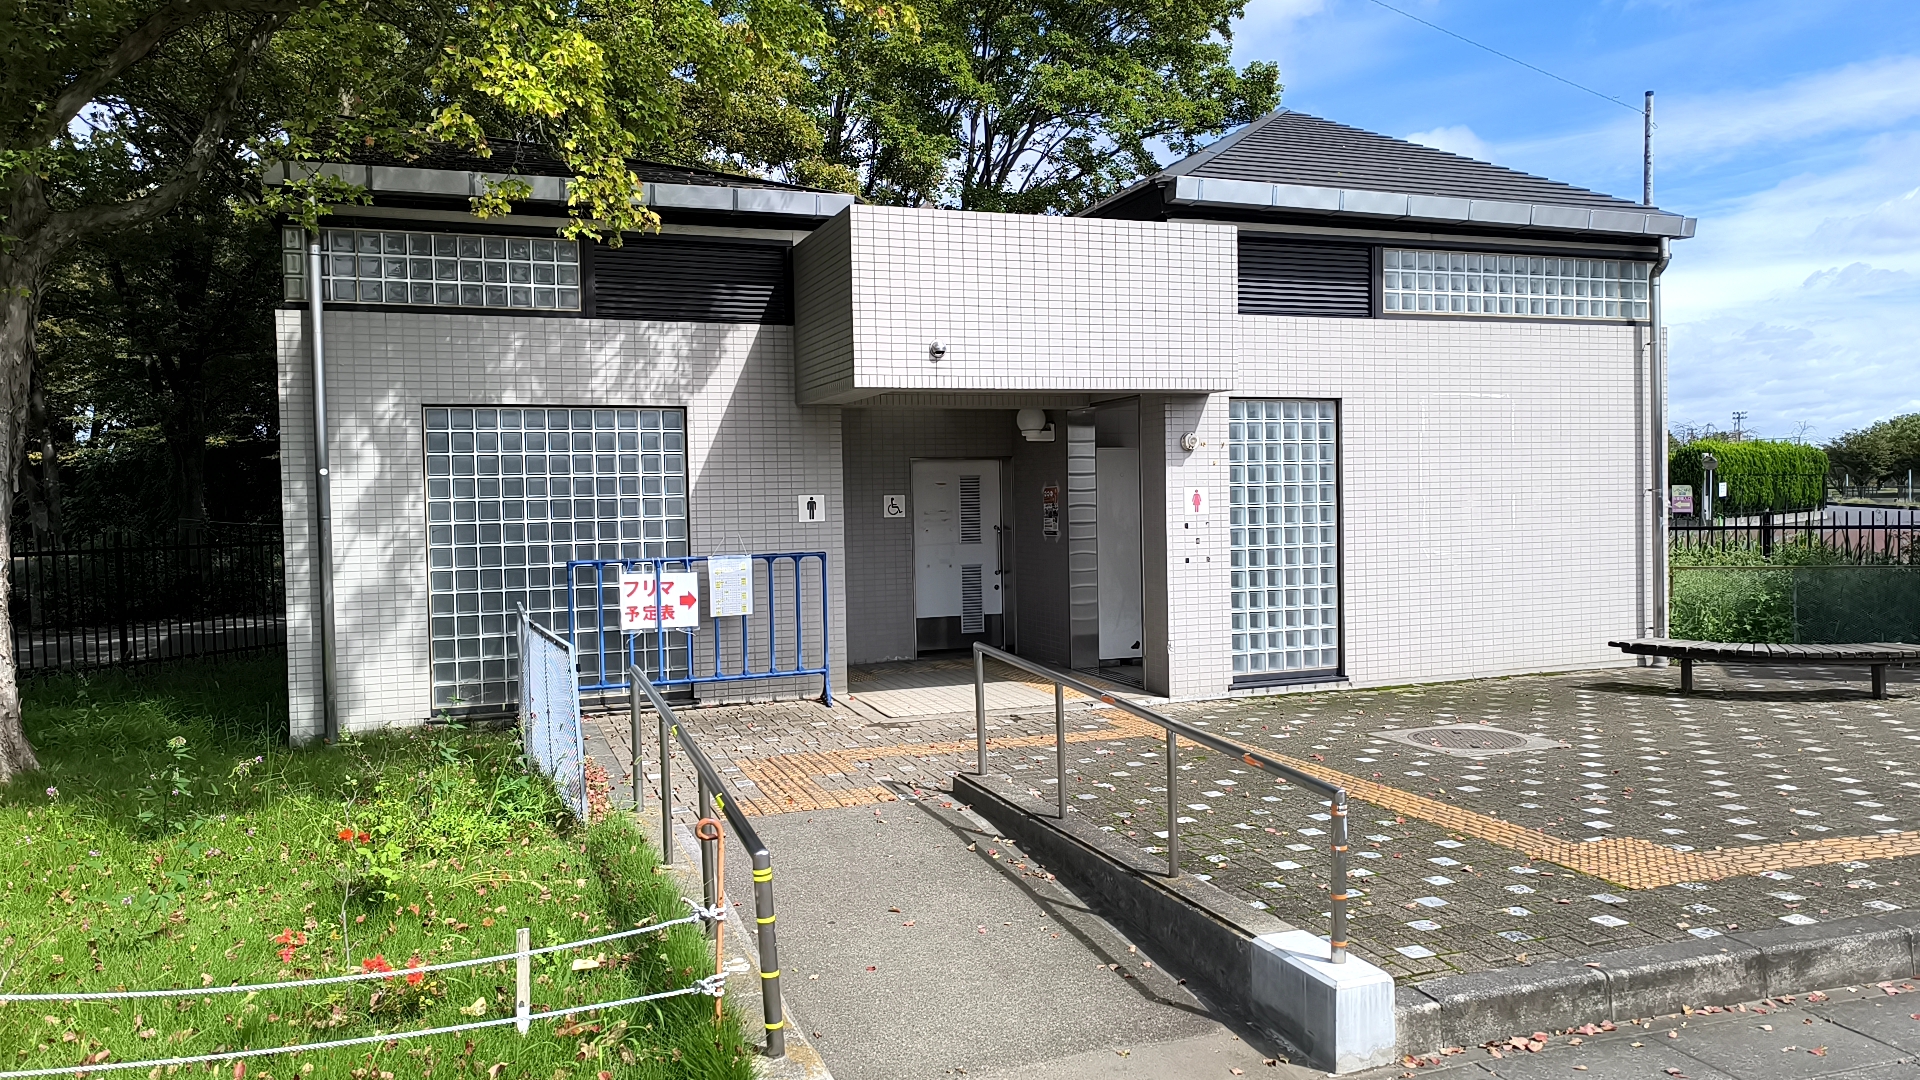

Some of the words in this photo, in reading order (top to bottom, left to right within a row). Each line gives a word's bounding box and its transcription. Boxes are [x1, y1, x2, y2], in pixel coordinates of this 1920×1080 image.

[624, 580, 674, 597] フリマ
[625, 604, 675, 622] 予定表
